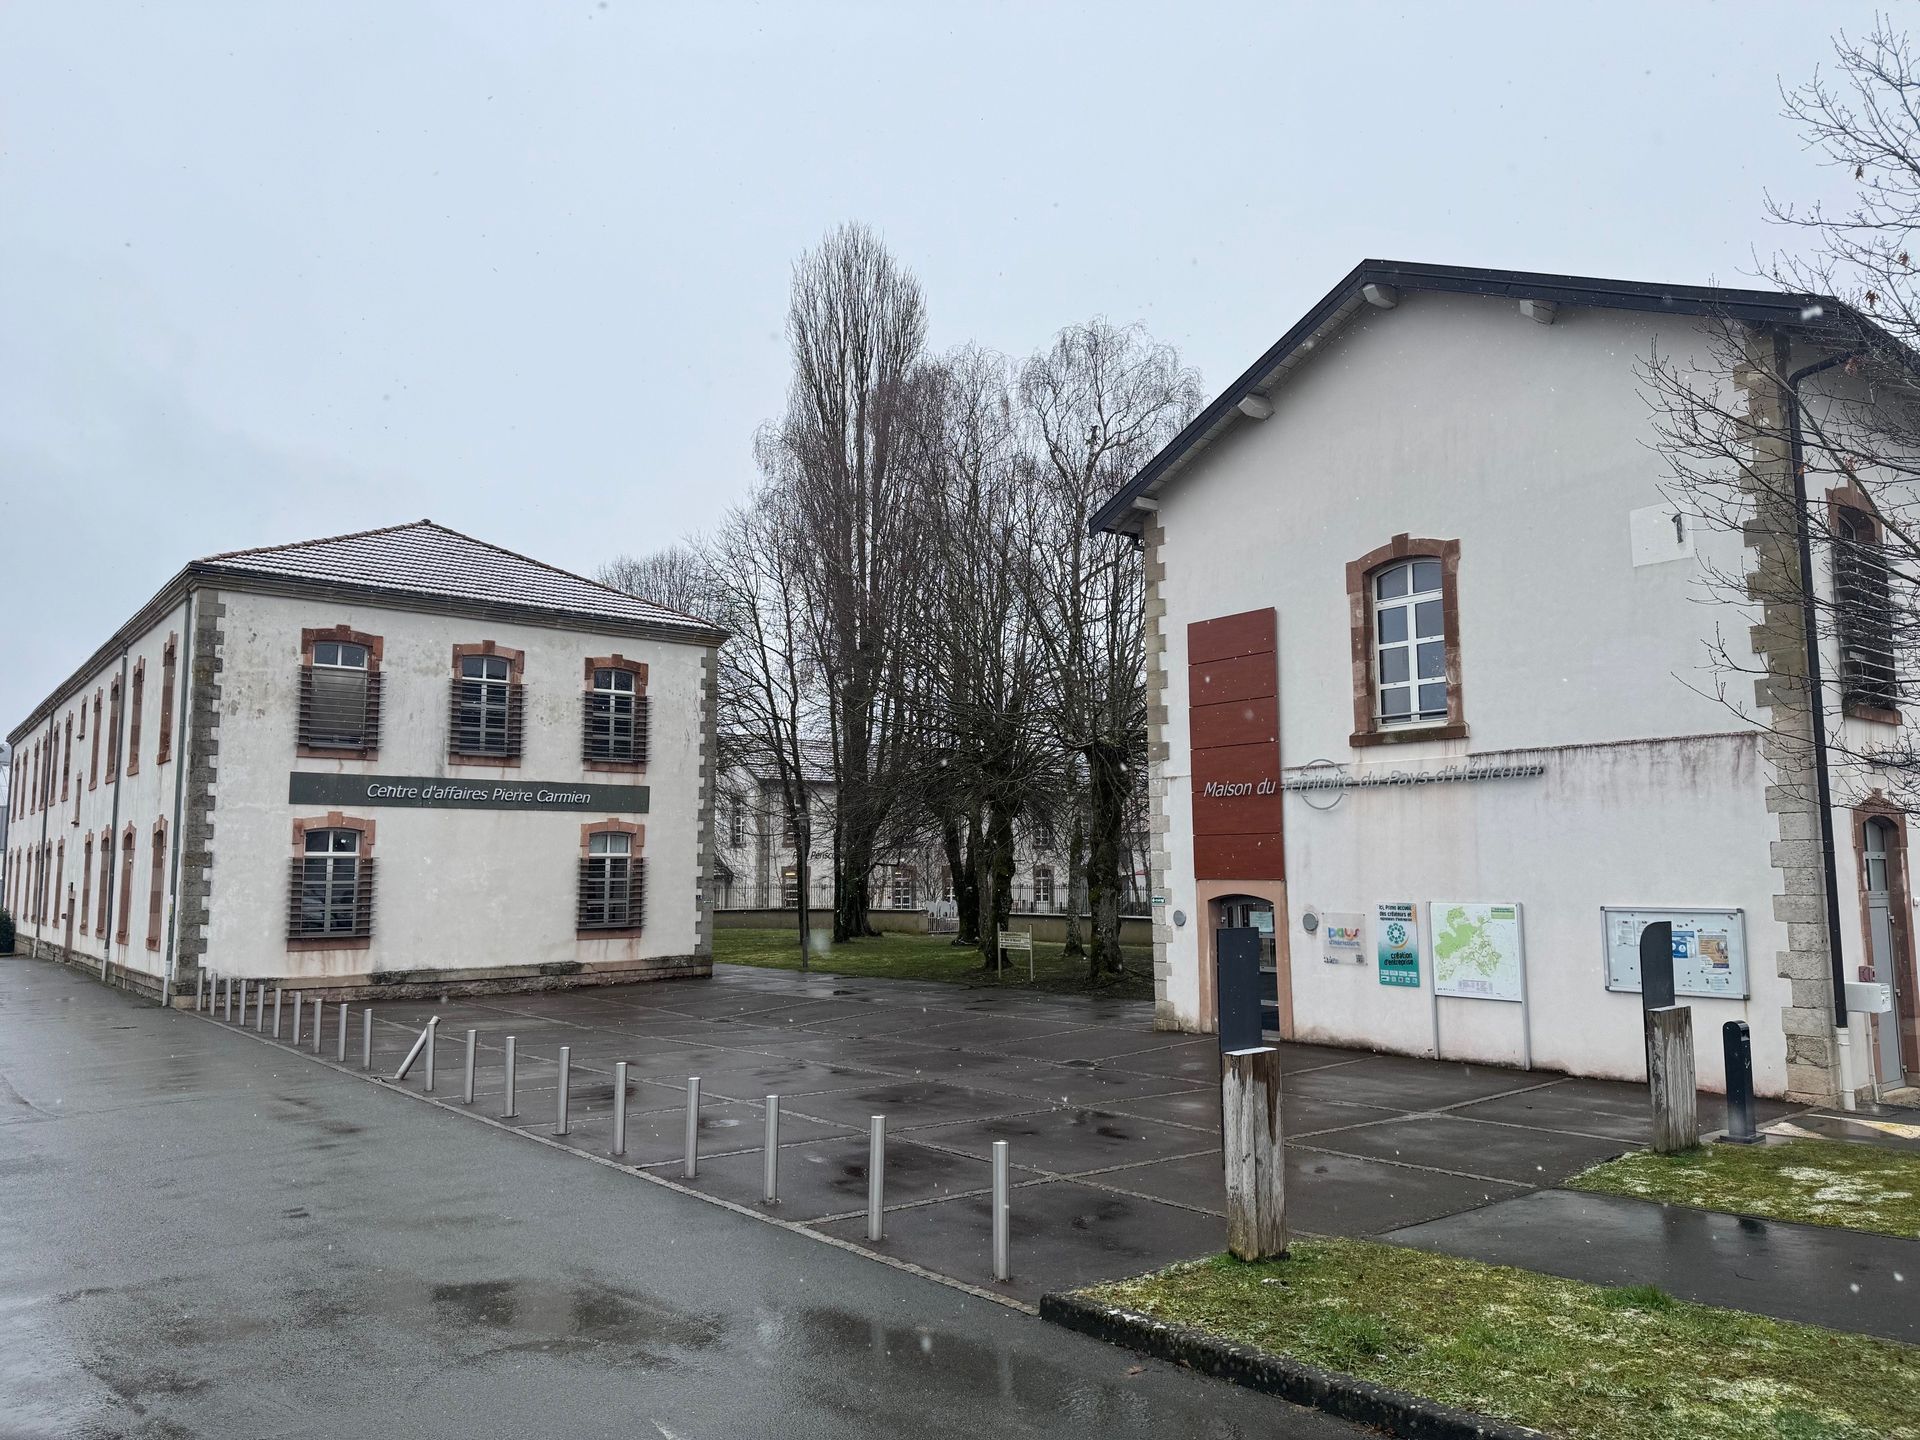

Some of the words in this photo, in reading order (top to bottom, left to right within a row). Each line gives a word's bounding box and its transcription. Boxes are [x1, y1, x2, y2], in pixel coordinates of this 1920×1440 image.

[1203, 780, 1252, 797] Maison
[1256, 777, 1276, 795] du
[1283, 774, 1354, 792] Territoire
[1359, 771, 1381, 788] du
[1387, 769, 1429, 790] Pays
[1434, 760, 1542, 784] d'Héricourt
[367, 783, 418, 799] Centre
[422, 785, 488, 801] d'affaires
[492, 788, 533, 802] Pierre
[536, 789, 591, 804] Carmien
[1391, 951, 1413, 959] création
[1384, 959, 1413, 967] d'entreprise
